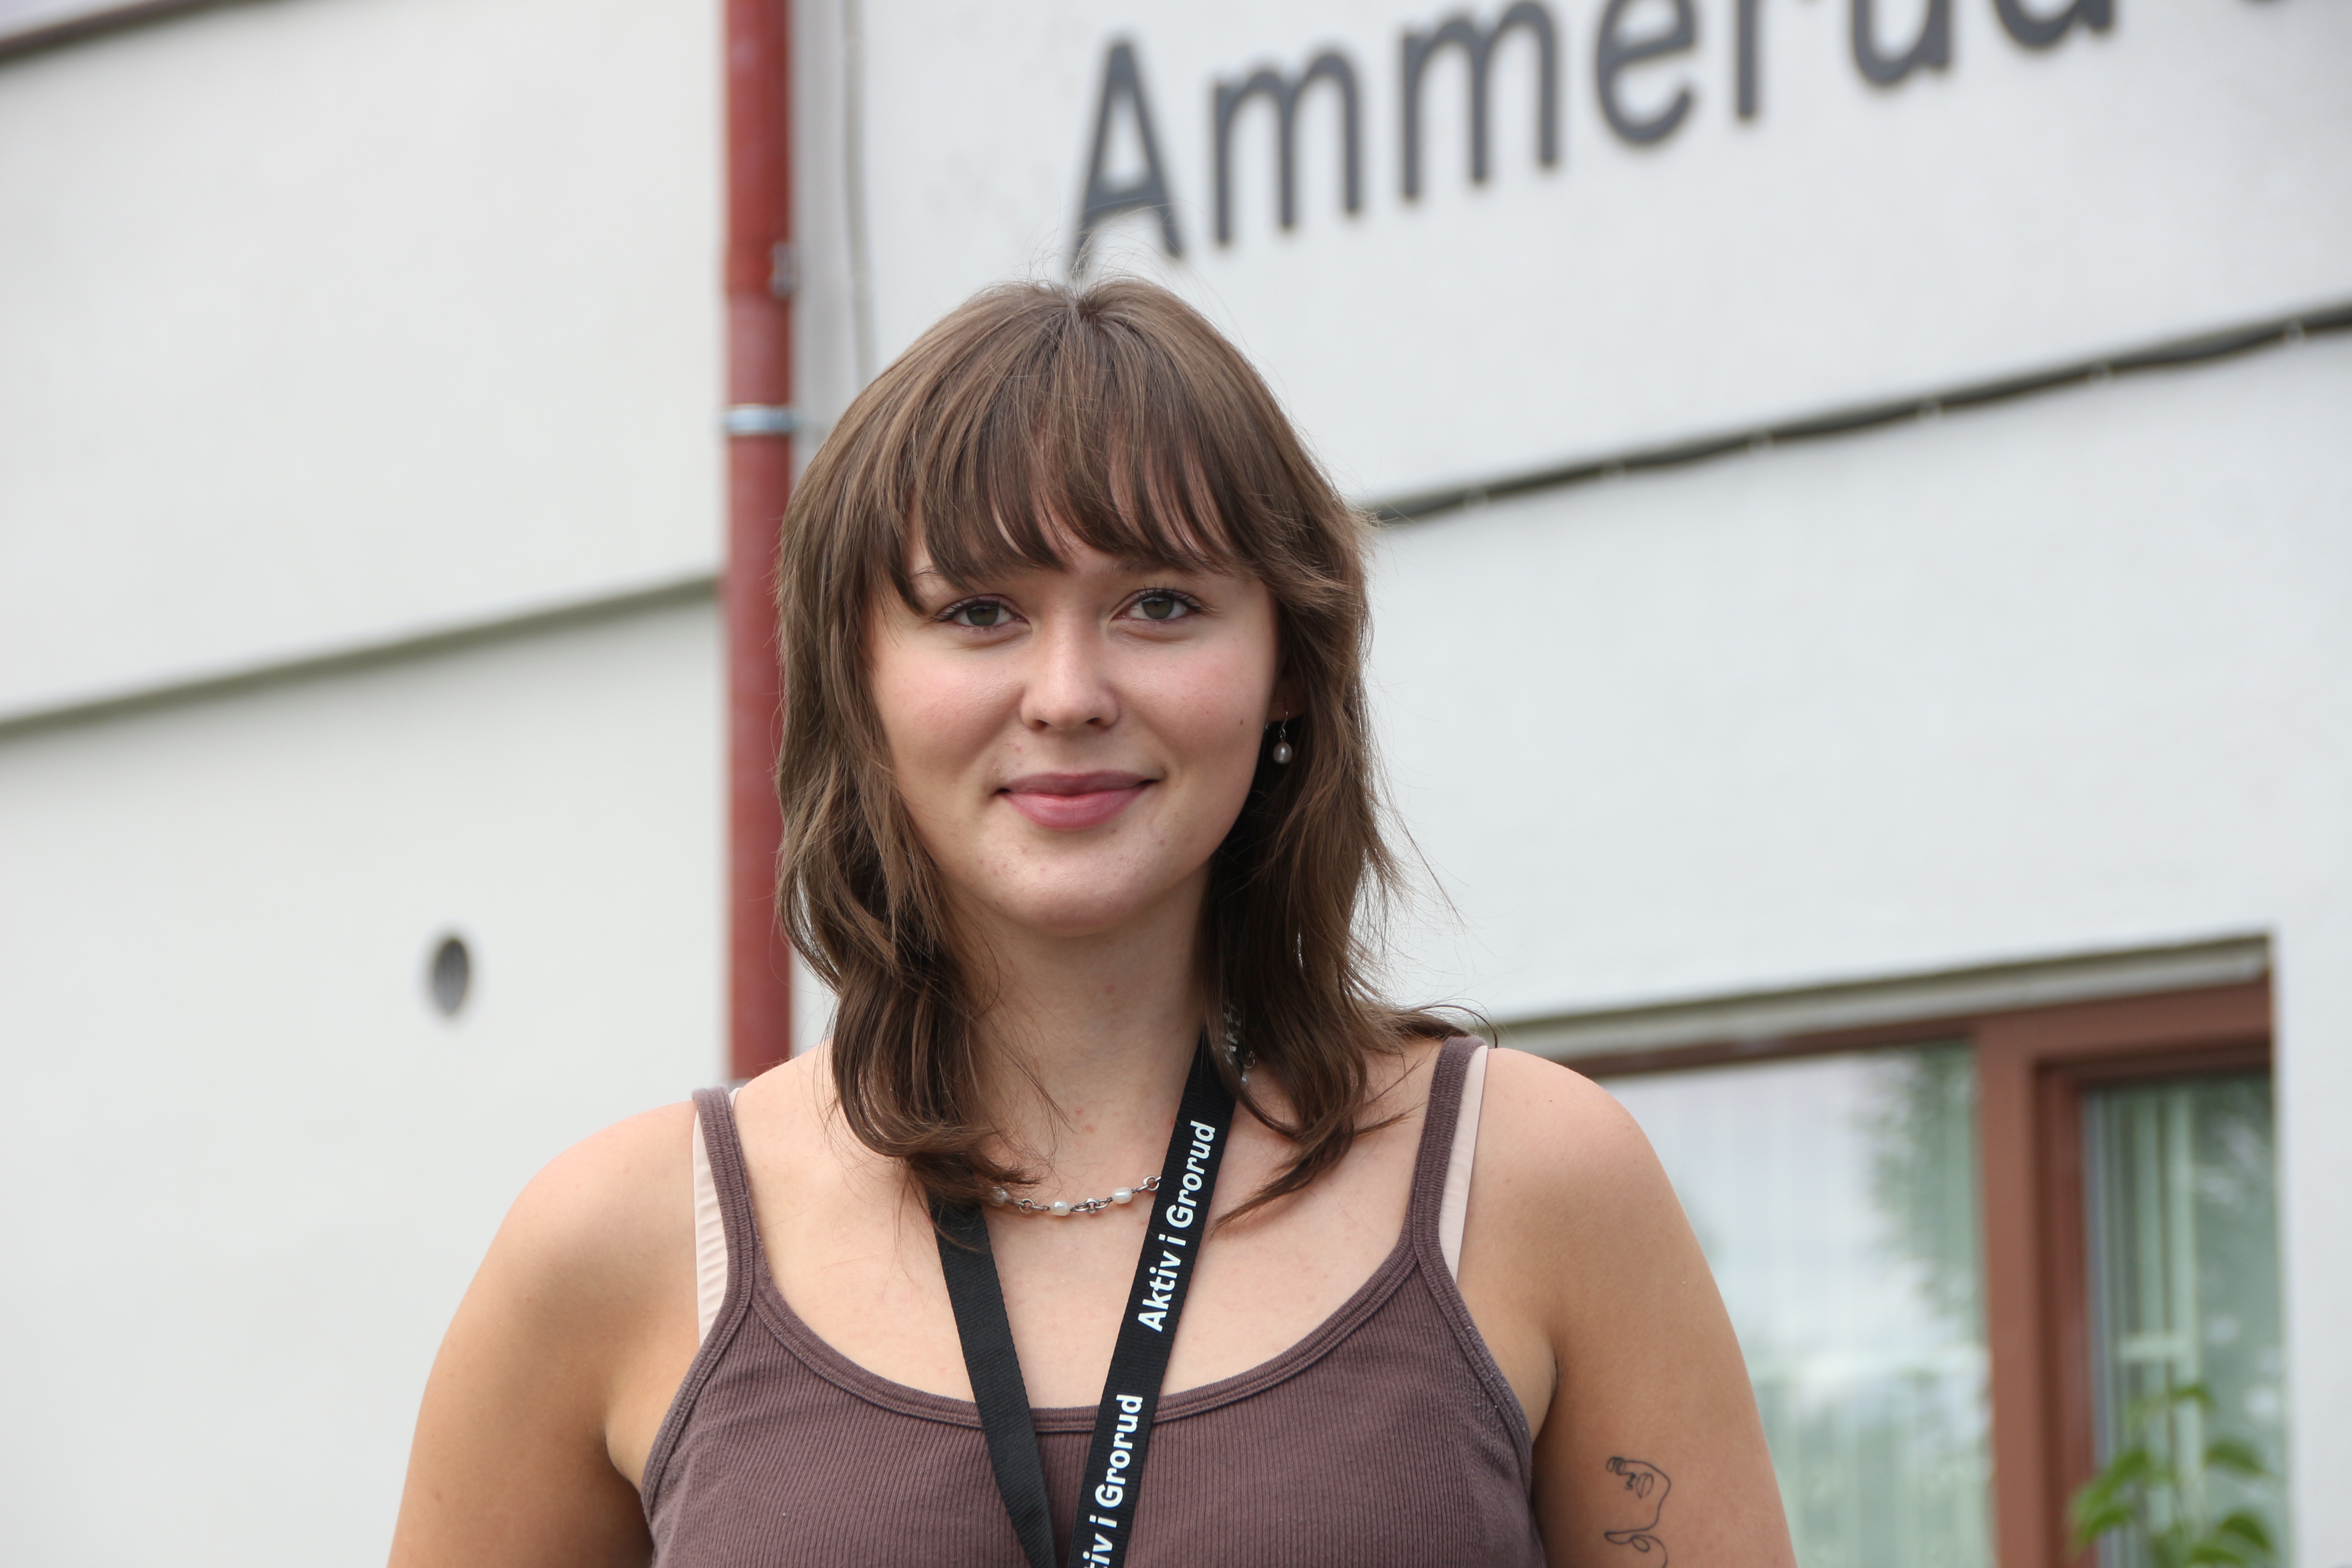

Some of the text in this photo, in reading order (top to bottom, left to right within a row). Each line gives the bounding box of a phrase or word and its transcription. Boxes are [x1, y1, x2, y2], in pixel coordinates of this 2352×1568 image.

[1062, 0, 2123, 274] Ammeru
[1137, 1120, 1215, 1332] Aktiv i Grorud
[1089, 1514, 1117, 1528] i
[1095, 1394, 1143, 1508] Grorud
